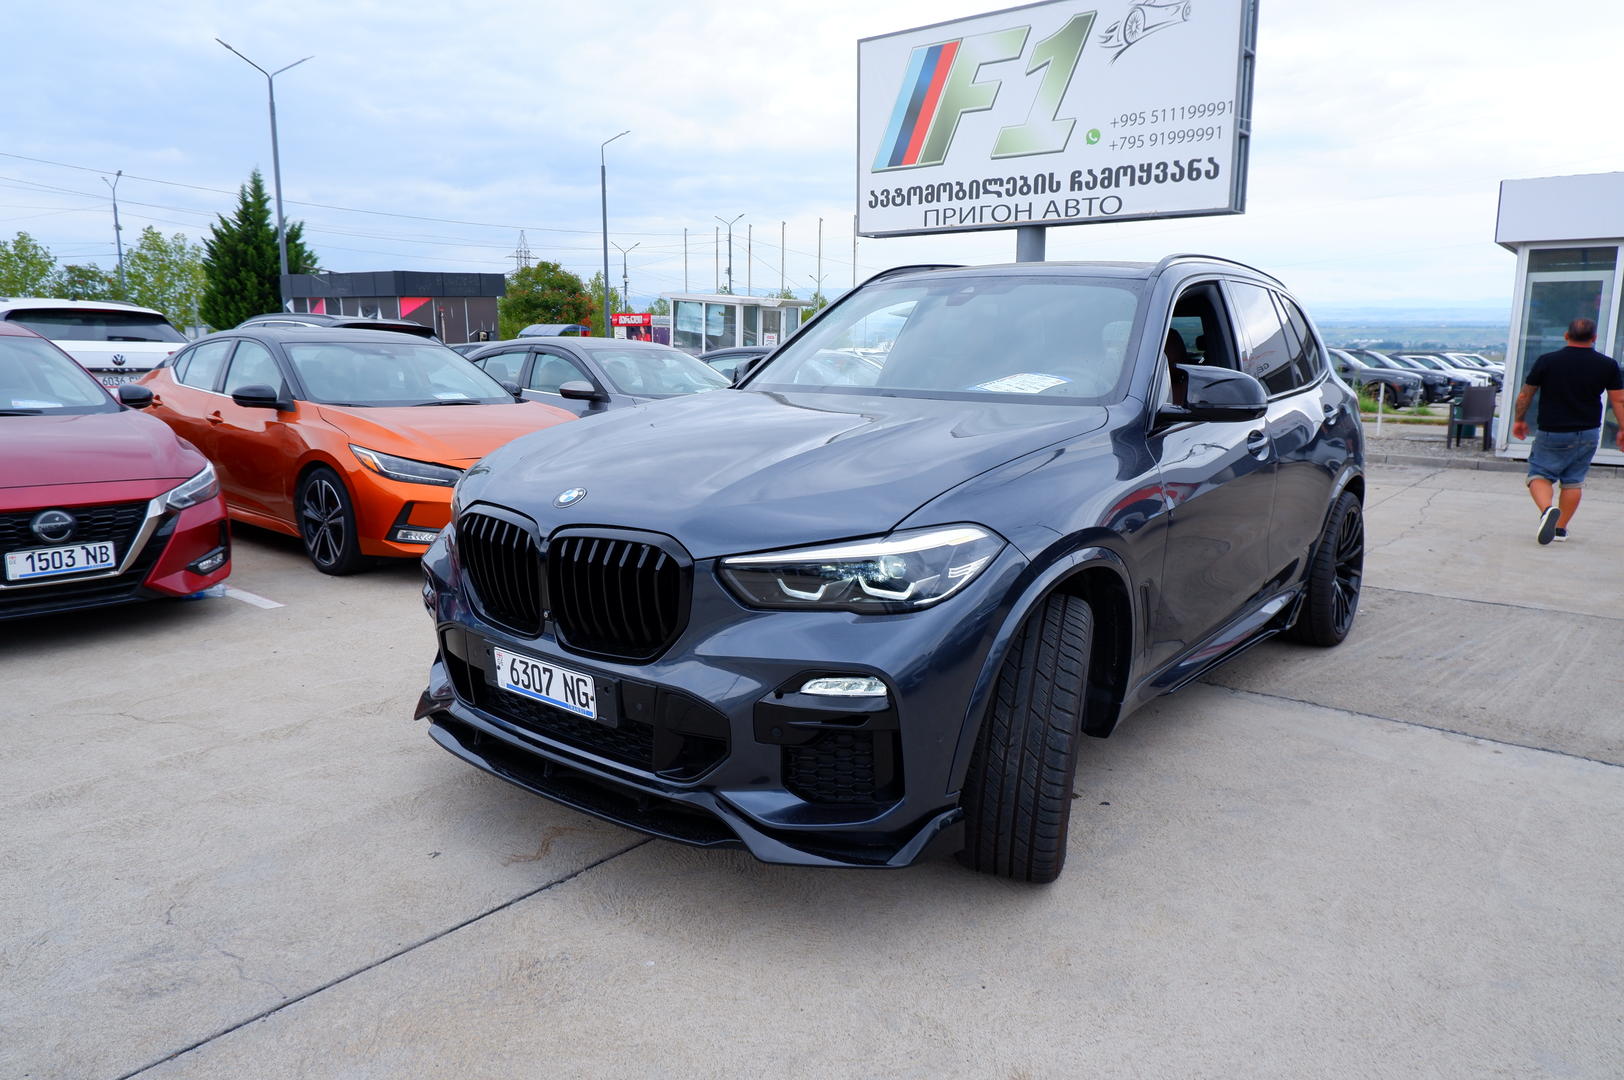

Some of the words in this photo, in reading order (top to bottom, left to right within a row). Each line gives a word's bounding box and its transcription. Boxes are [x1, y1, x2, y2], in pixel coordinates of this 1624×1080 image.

[917, 10, 1097, 166] F1
[1110, 112, 1146, 128] +995
[1150, 100, 1233, 124] 511199991
[1109, 134, 1145, 150] +795
[1149, 125, 1222, 147] 91999991
[868, 172, 1061, 209] ავტომობილების
[1069, 157, 1220, 192] ჩამოყვანა
[924, 202, 1033, 227] ПРИГОН
[1042, 195, 1123, 219] АВТО
[25, 548, 76, 573] 1503
[81, 545, 110, 565] NB
[510, 657, 553, 696] 6307
[562, 673, 590, 709] NG
